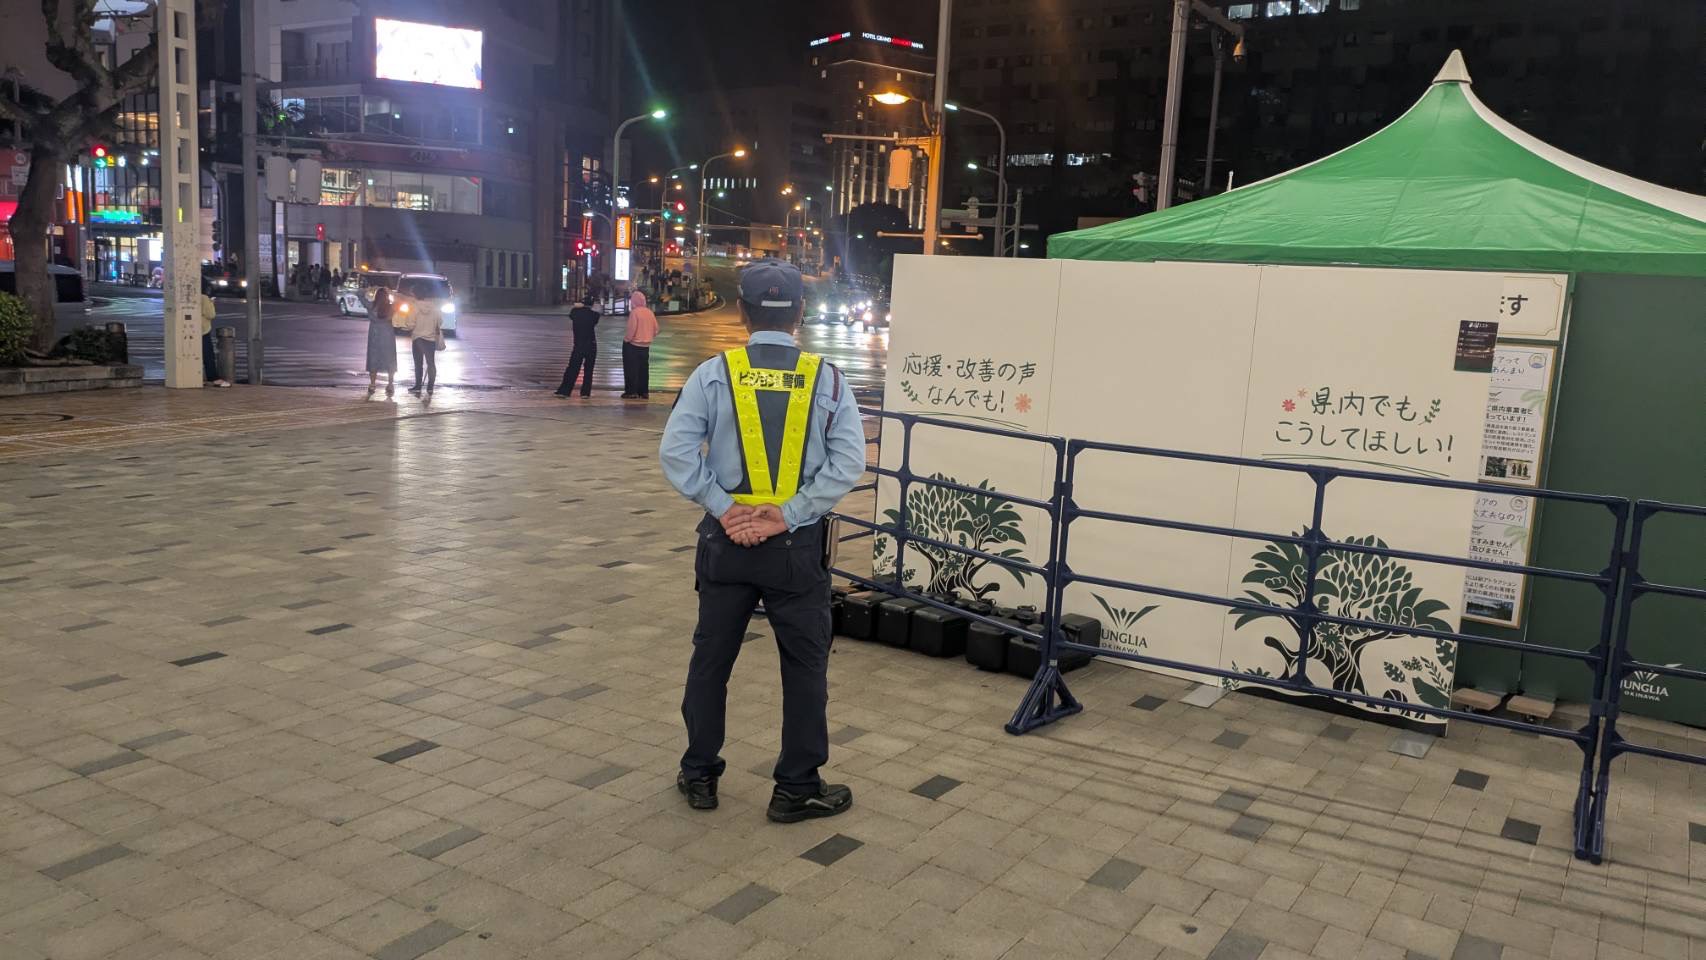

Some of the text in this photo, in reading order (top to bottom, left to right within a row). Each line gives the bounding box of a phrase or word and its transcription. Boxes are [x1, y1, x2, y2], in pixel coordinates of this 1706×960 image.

[902, 353, 1037, 385] 応援・改善の声
[927, 384, 1006, 413] なんでも!
[1311, 387, 1417, 421] 県内でも
[1275, 421, 1454, 463] こうしてほしい!
[1101, 628, 1148, 649] UNGLIA
[1624, 690, 1660, 702] OKINAWA
